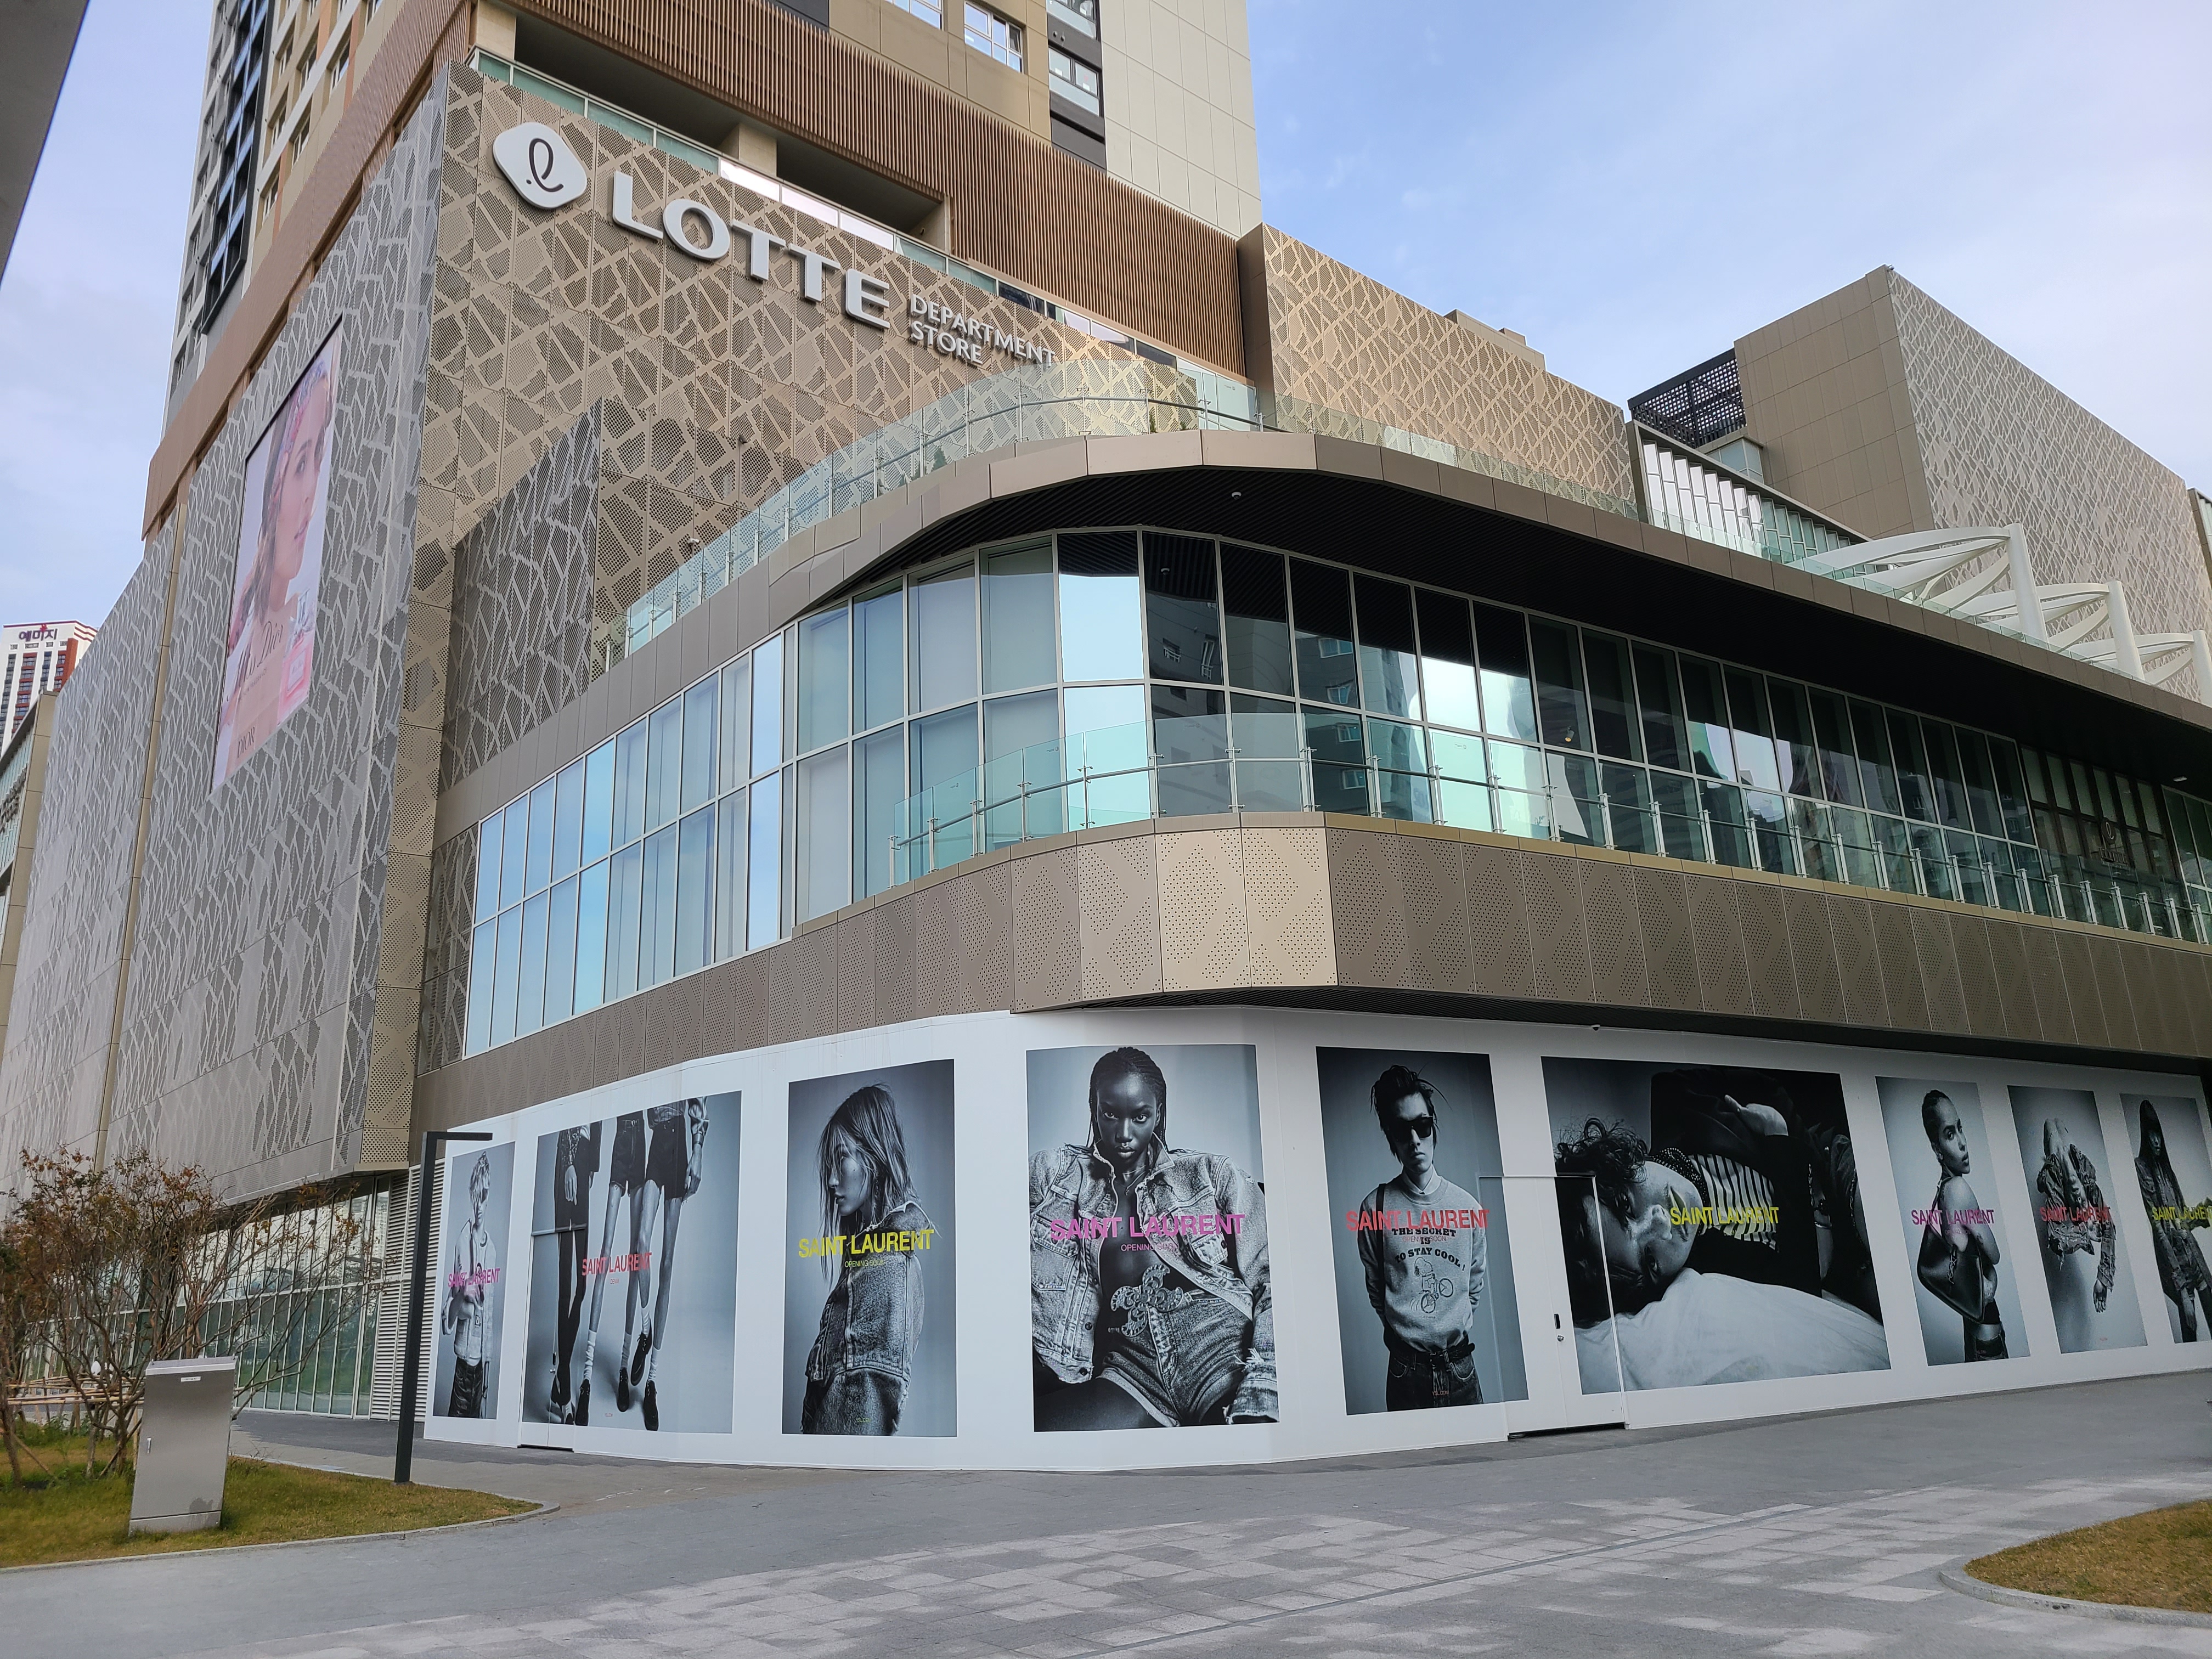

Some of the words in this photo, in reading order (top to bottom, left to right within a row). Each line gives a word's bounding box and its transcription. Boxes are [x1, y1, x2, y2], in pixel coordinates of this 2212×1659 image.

[612, 171, 890, 329] LOTTE
[911, 294, 1056, 368] DEPARTMENT
[911, 320, 983, 365] STORE
[19, 628, 58, 642] 예미지
[238, 726, 256, 759] DIOR
[1346, 1210, 1401, 1231] SAINT
[1407, 1209, 1490, 1229] LAURENT
[1671, 1206, 1713, 1225] SAINT
[1718, 1206, 1779, 1224] LAURENT
[1911, 1209, 1943, 1225] SAINT
[1946, 1209, 1994, 1224] LAURENT
[2040, 1206, 2067, 1222] SAINT
[2069, 1206, 2111, 1221] LAURENT
[2152, 1206, 2176, 1220] SAINT
[1050, 1216, 1122, 1240] SAINT
[1130, 1214, 1245, 1237] LAURENT
[1392, 1227, 1413, 1235] THE
[1415, 1227, 1457, 1237] SECRET
[798, 1235, 847, 1258] SAINT
[851, 1229, 934, 1254] LAURENT
[582, 1256, 607, 1276] SAINT
[609, 1252, 652, 1273] LAURENT
[1395, 1252, 1406, 1263] TO
[1408, 1247, 1432, 1257] STAY
